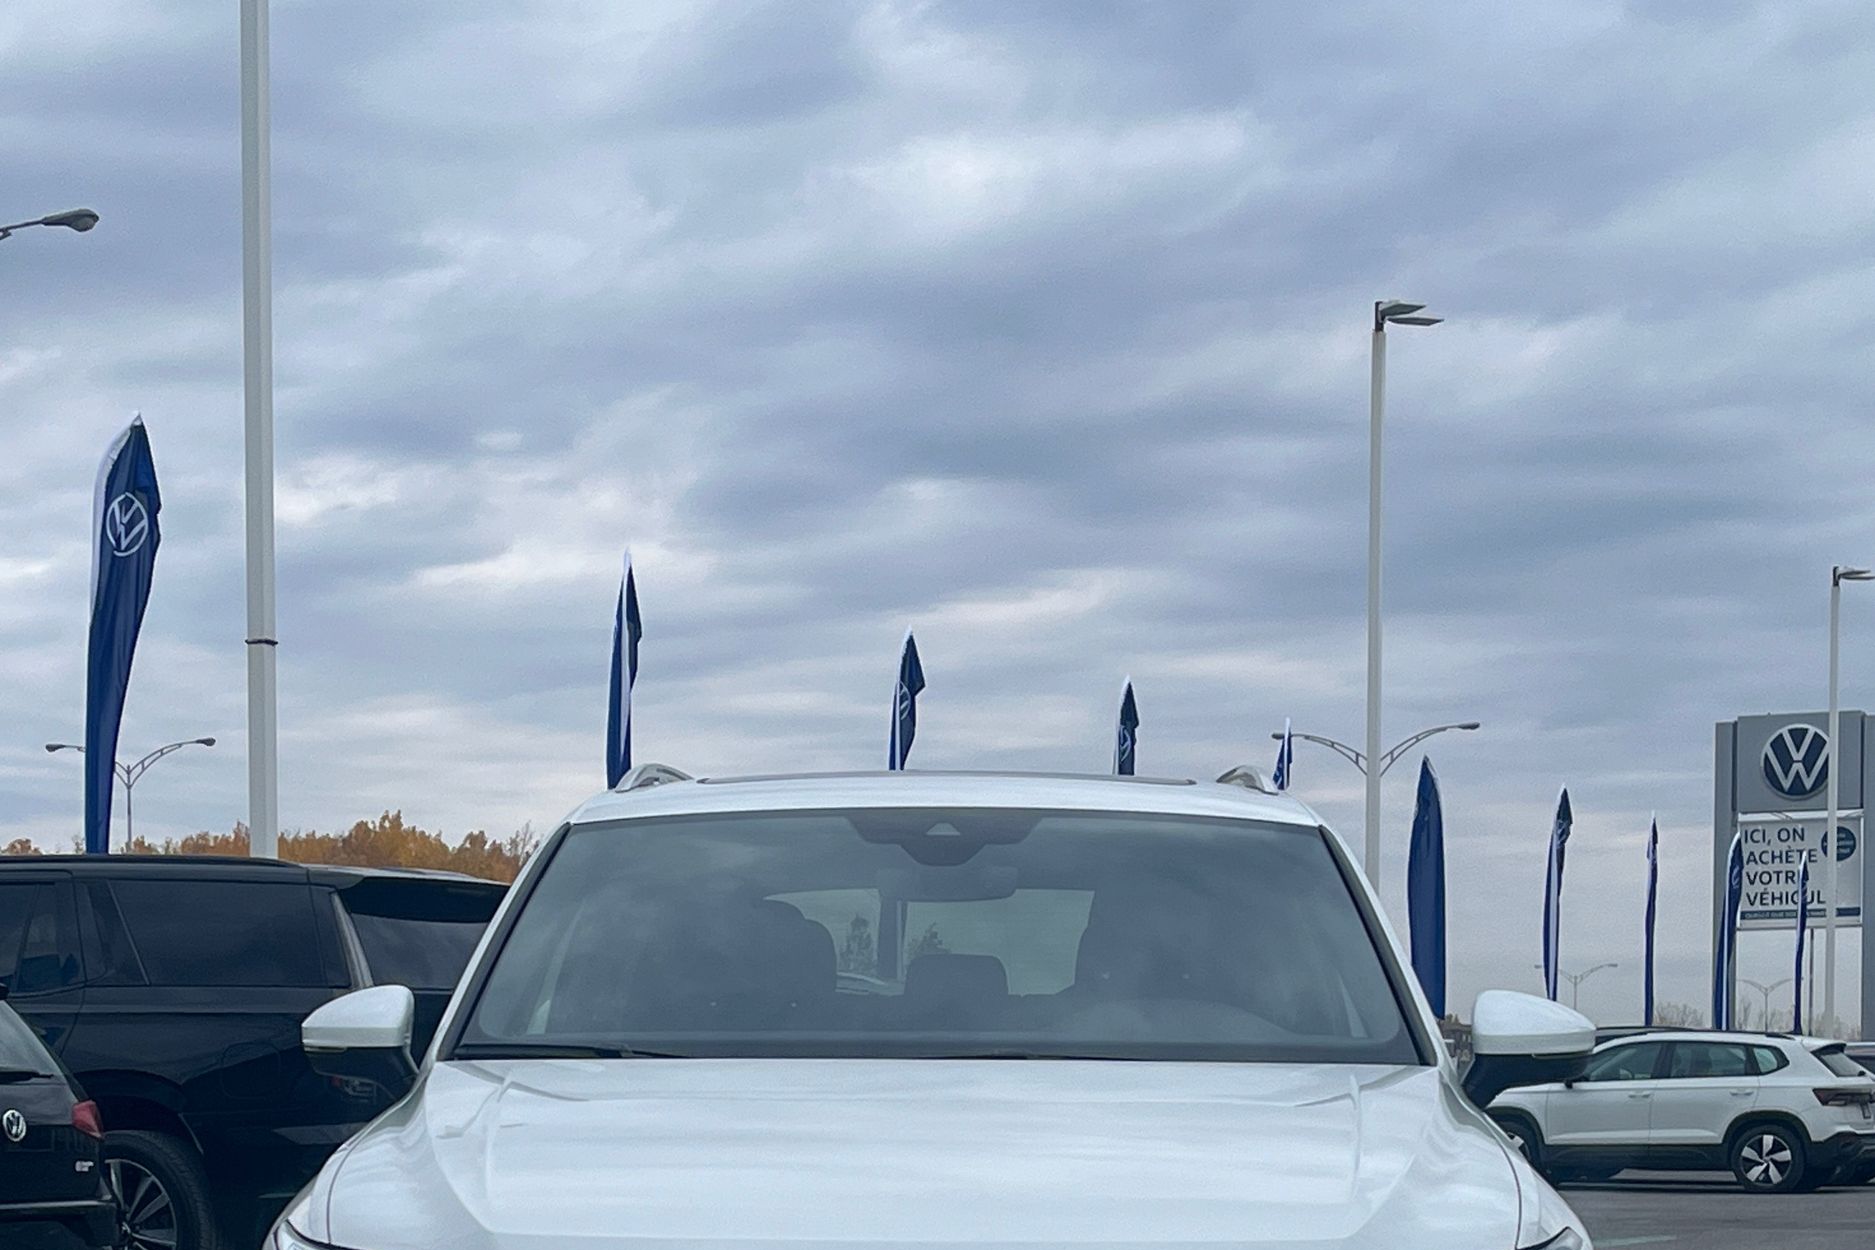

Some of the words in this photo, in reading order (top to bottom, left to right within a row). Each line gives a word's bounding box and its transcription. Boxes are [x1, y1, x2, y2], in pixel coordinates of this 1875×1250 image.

[1764, 727, 1832, 793] VW
[1744, 828, 1772, 846] ICI,
[1777, 827, 1805, 842] ON
[1745, 869, 1797, 886] VOTR
[1745, 887, 1827, 907] VÉHICUL
